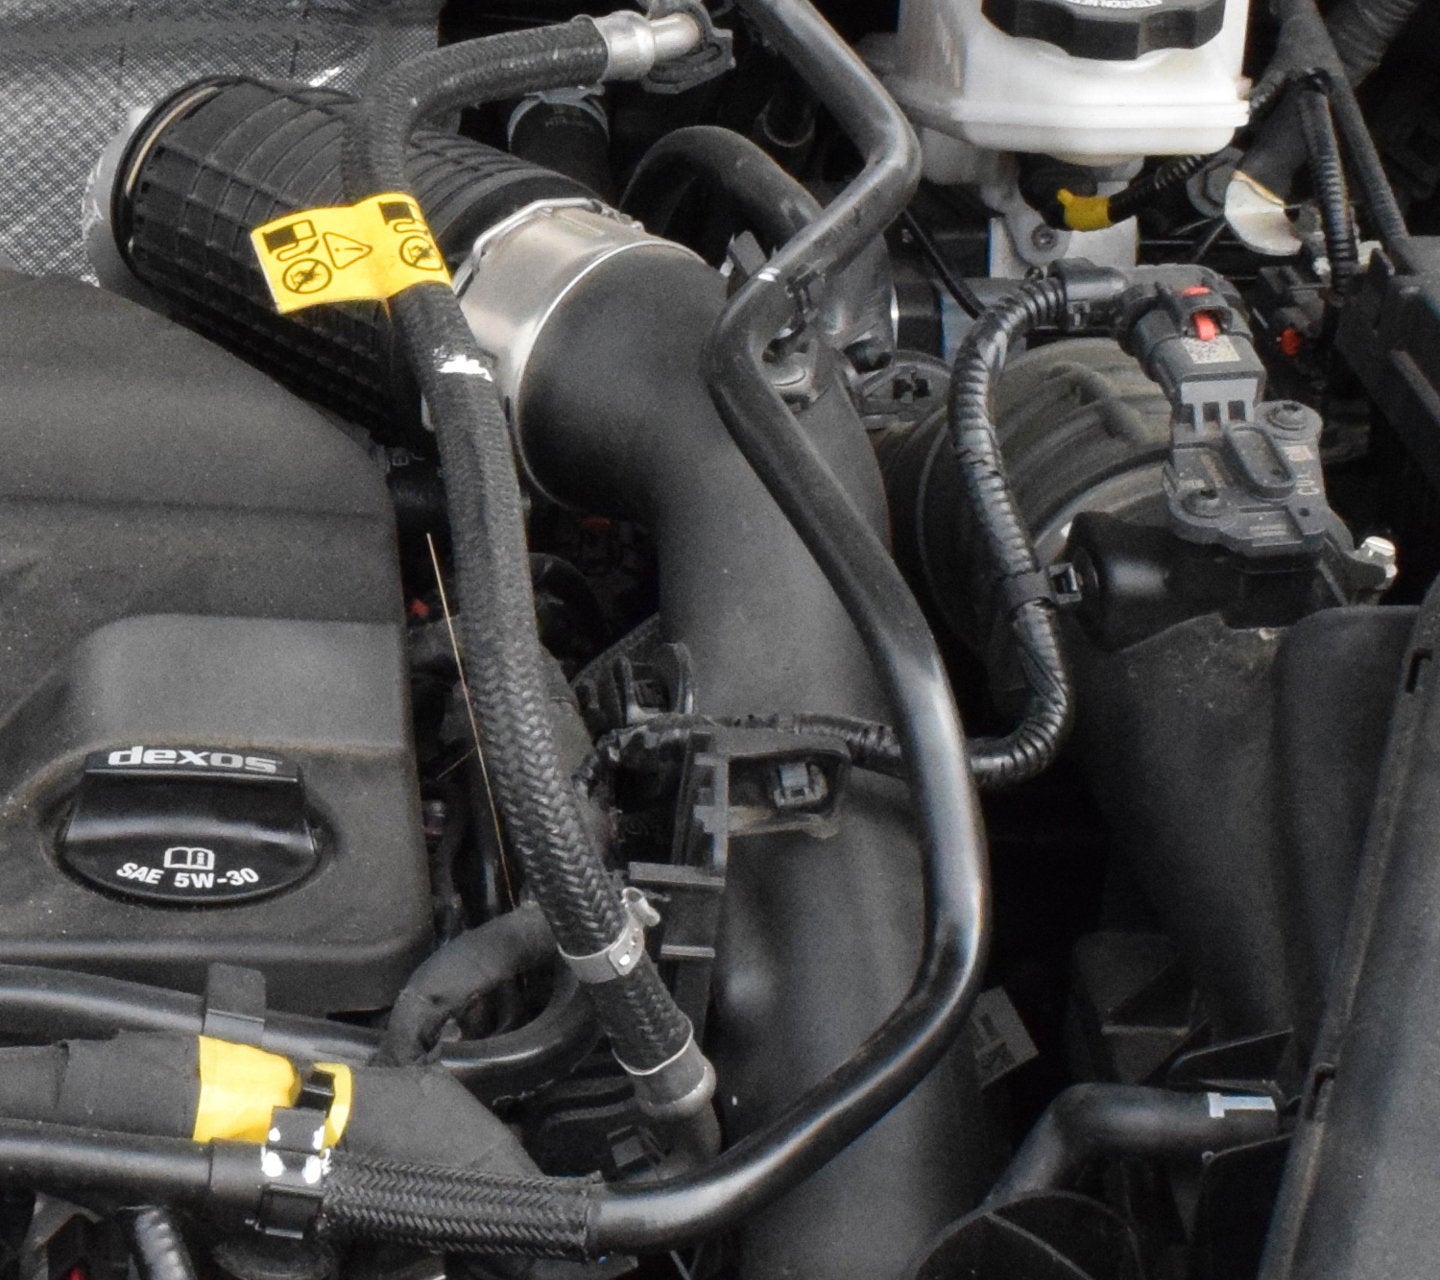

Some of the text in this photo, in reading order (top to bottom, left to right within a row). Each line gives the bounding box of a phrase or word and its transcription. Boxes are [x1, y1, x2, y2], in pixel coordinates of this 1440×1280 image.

[108, 746, 278, 775] dexos
[116, 862, 260, 889] SAE 5W-30
